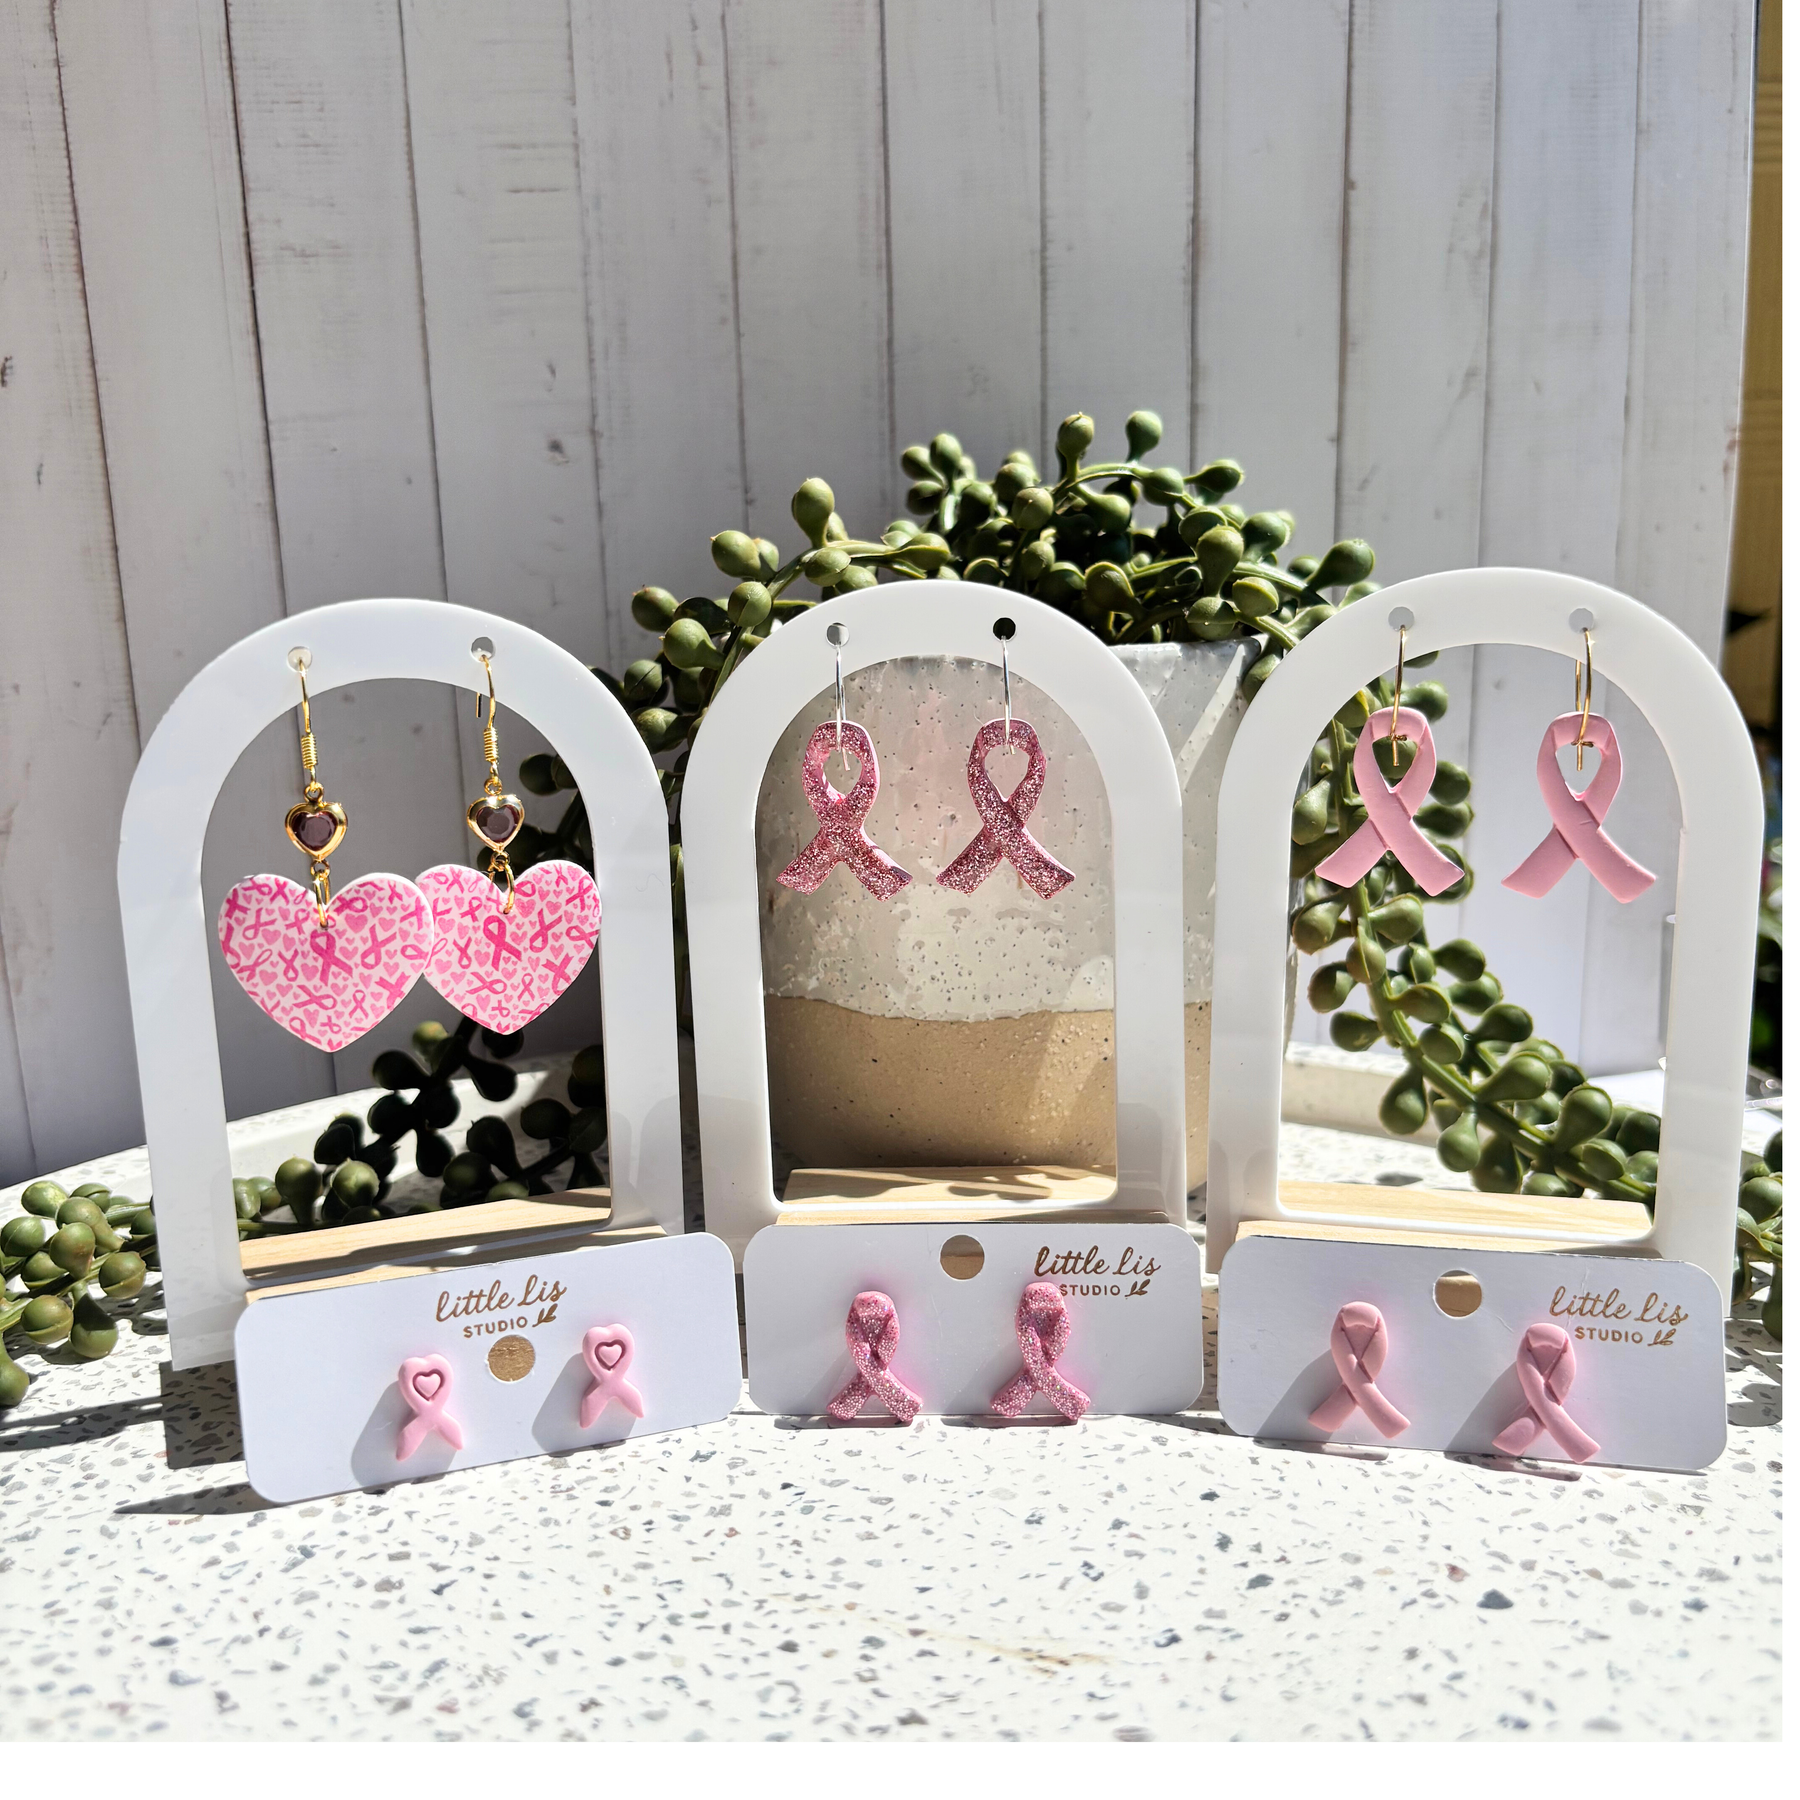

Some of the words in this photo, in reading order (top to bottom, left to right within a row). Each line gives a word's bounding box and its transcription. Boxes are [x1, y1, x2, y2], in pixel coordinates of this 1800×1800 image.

[1059, 1284, 1121, 1296] STUDIO
[463, 1316, 528, 1338] STUDIO
[1574, 1326, 1643, 1343] STUDIO
